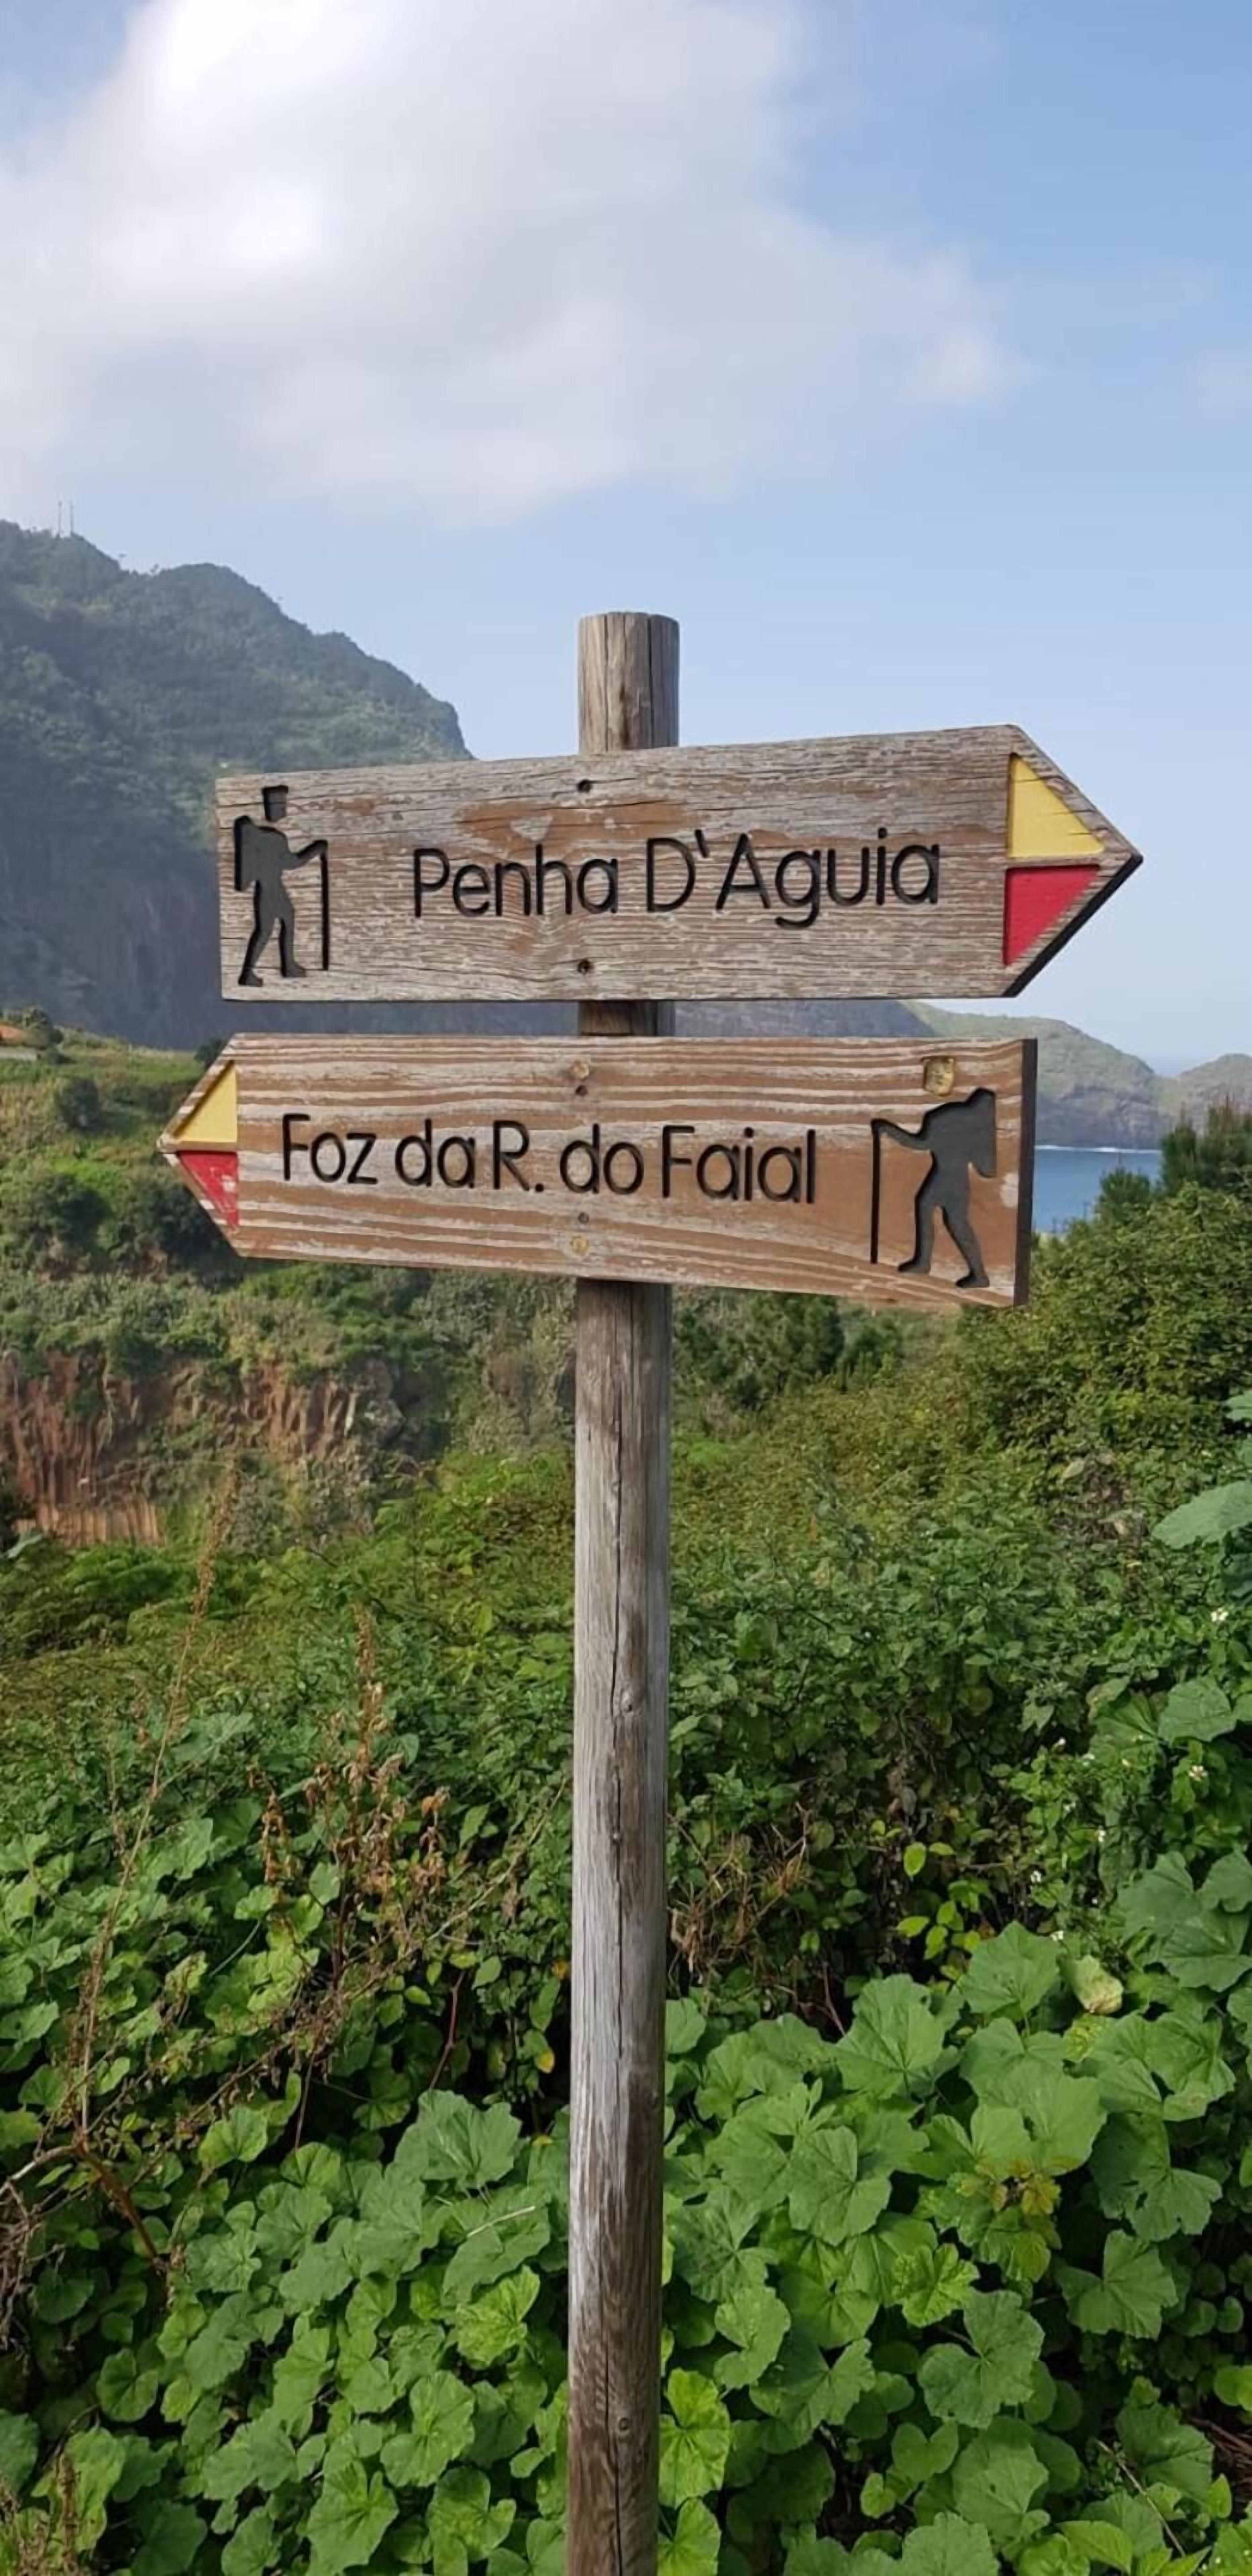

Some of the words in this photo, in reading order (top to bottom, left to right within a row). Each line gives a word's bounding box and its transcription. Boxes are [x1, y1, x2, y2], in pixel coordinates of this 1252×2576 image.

[414, 844, 619, 918] Penha
[282, 1113, 378, 1185] Foz
[395, 1119, 476, 1188] da
[493, 1120, 544, 1192] R.
[560, 1123, 644, 1195] do
[662, 1125, 816, 1204] Faial
